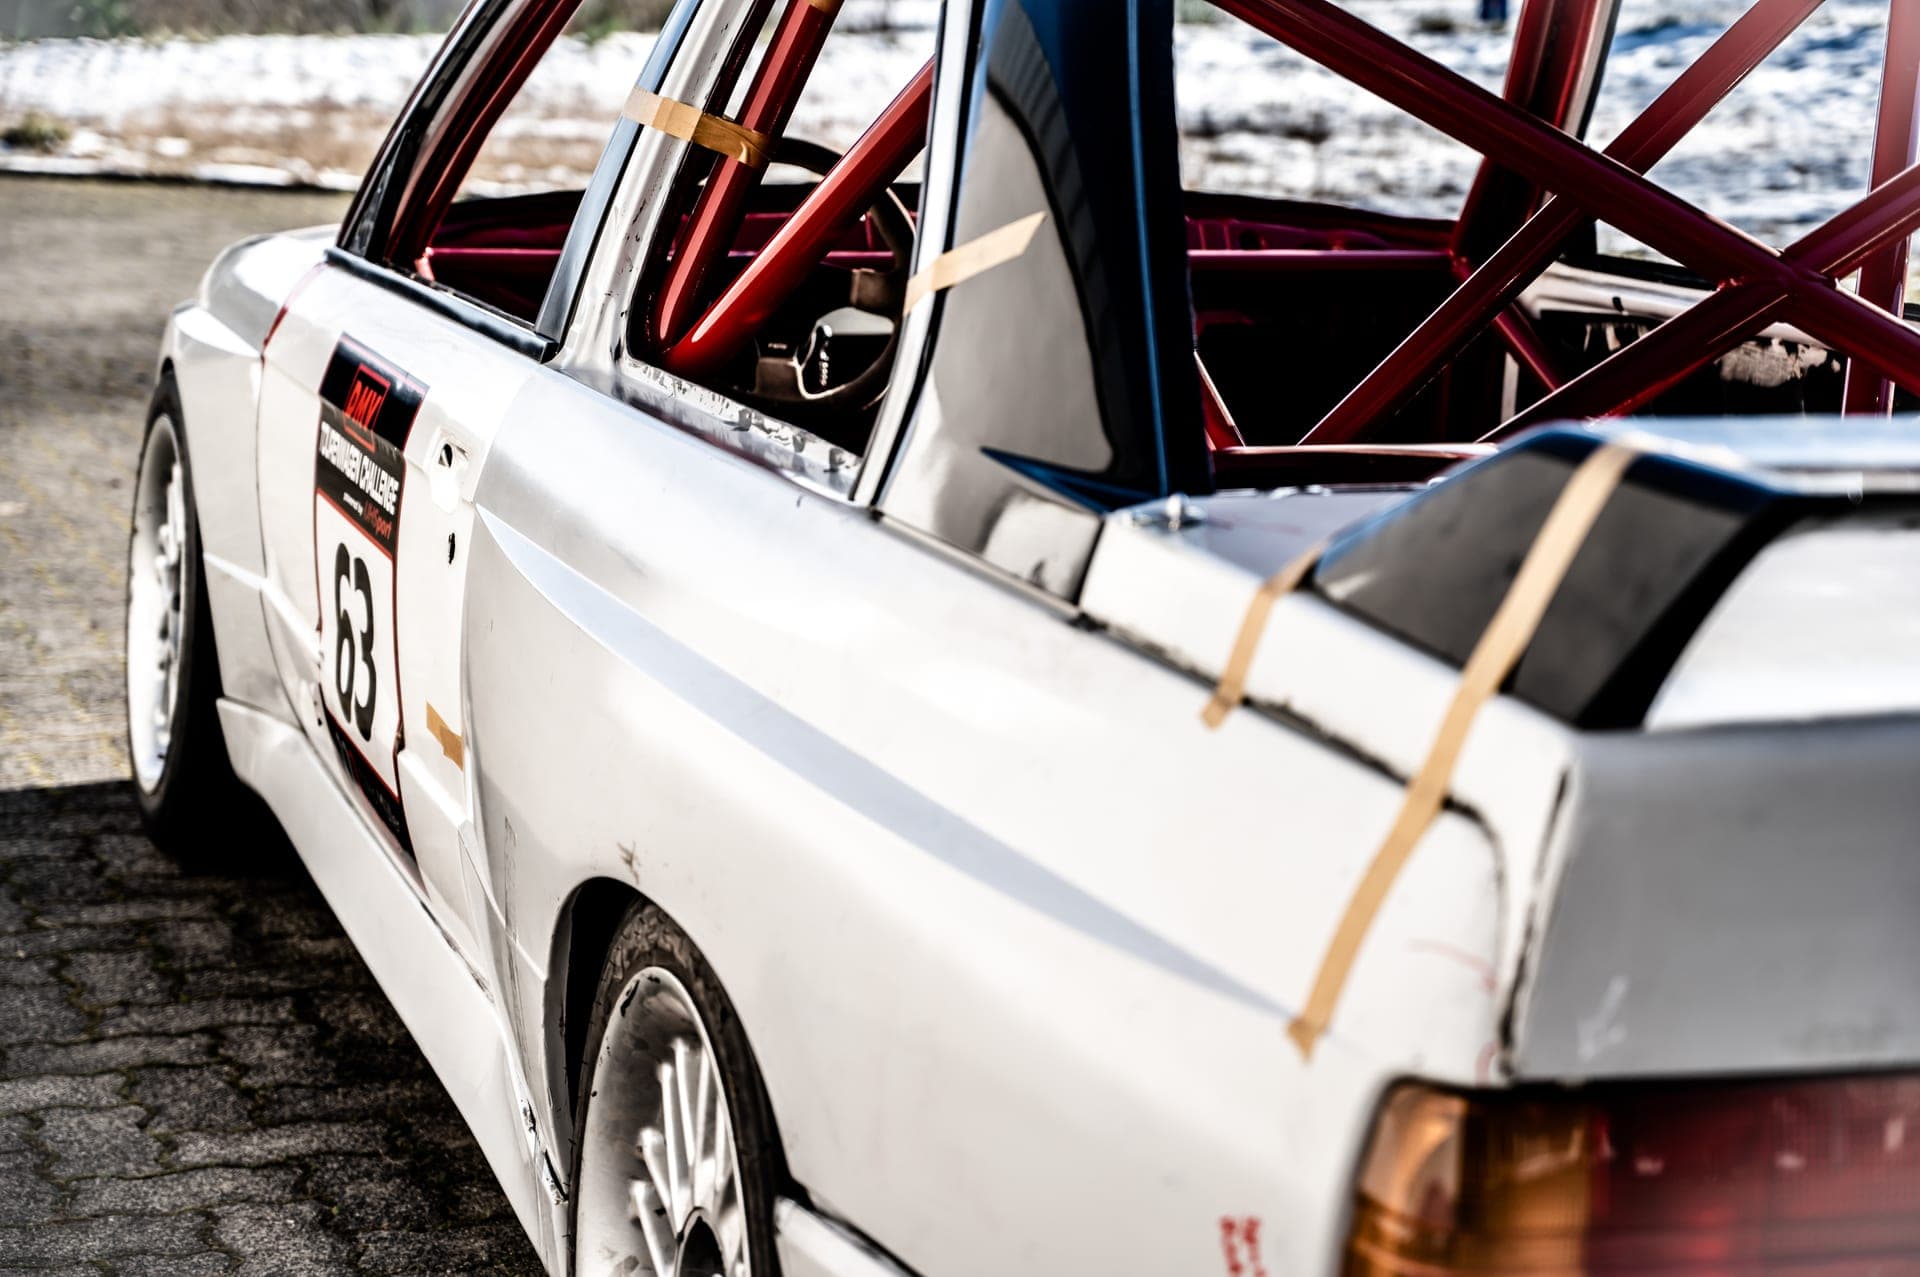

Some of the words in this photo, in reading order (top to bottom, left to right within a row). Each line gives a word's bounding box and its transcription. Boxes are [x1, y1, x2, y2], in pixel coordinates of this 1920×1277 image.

[344, 380, 383, 431] DMV
[320, 420, 363, 485] TOURENWAGEN
[359, 455, 399, 516] CHALLENGE
[335, 543, 376, 741] 63
